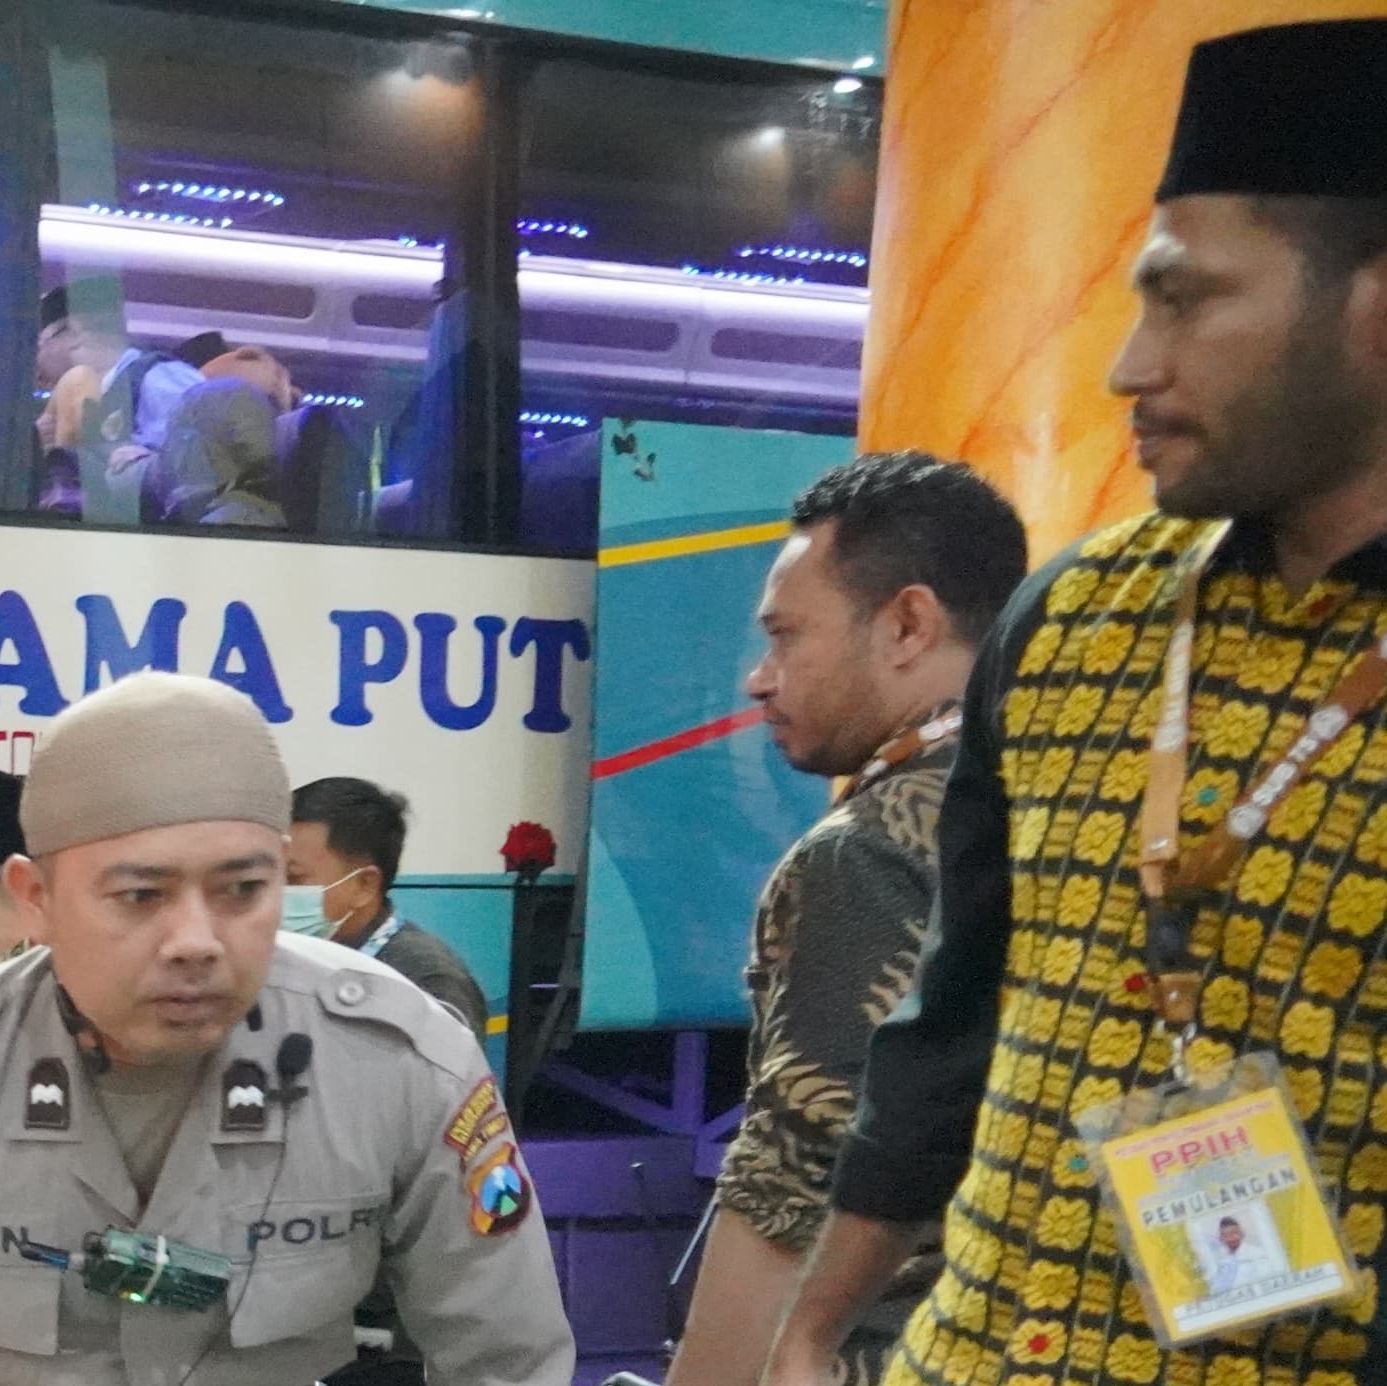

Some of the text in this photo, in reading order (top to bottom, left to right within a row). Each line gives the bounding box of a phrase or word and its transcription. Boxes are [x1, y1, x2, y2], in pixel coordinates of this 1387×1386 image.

[1150, 1125, 1250, 1176] PPIH
[1141, 1166, 1298, 1227] PEMULANGAN
[247, 1206, 385, 1251] POLR
